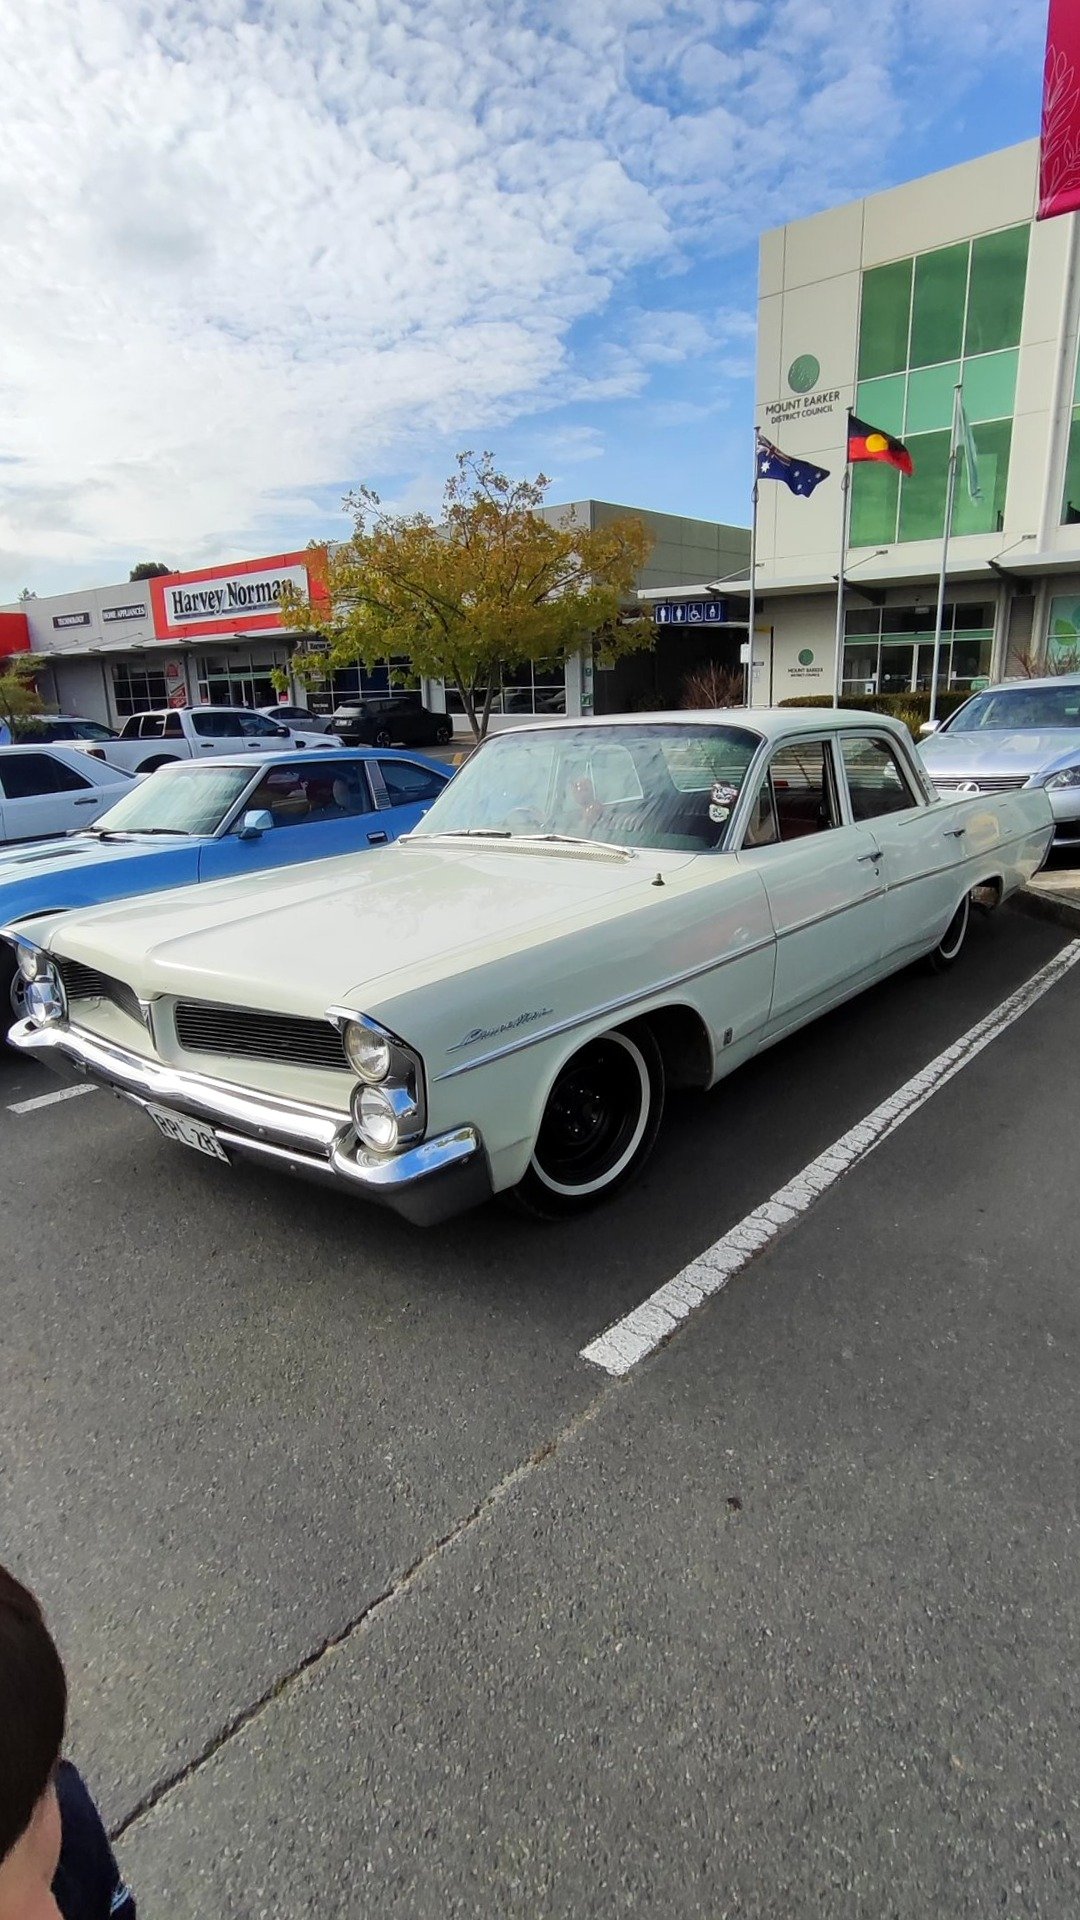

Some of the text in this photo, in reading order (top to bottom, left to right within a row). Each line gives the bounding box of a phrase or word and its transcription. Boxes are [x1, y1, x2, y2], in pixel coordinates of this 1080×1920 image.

[766, 399, 801, 415] MOUNT
[771, 405, 833, 424] DISTRICT COUNCIL
[172, 579, 293, 615] Harvey Norman
